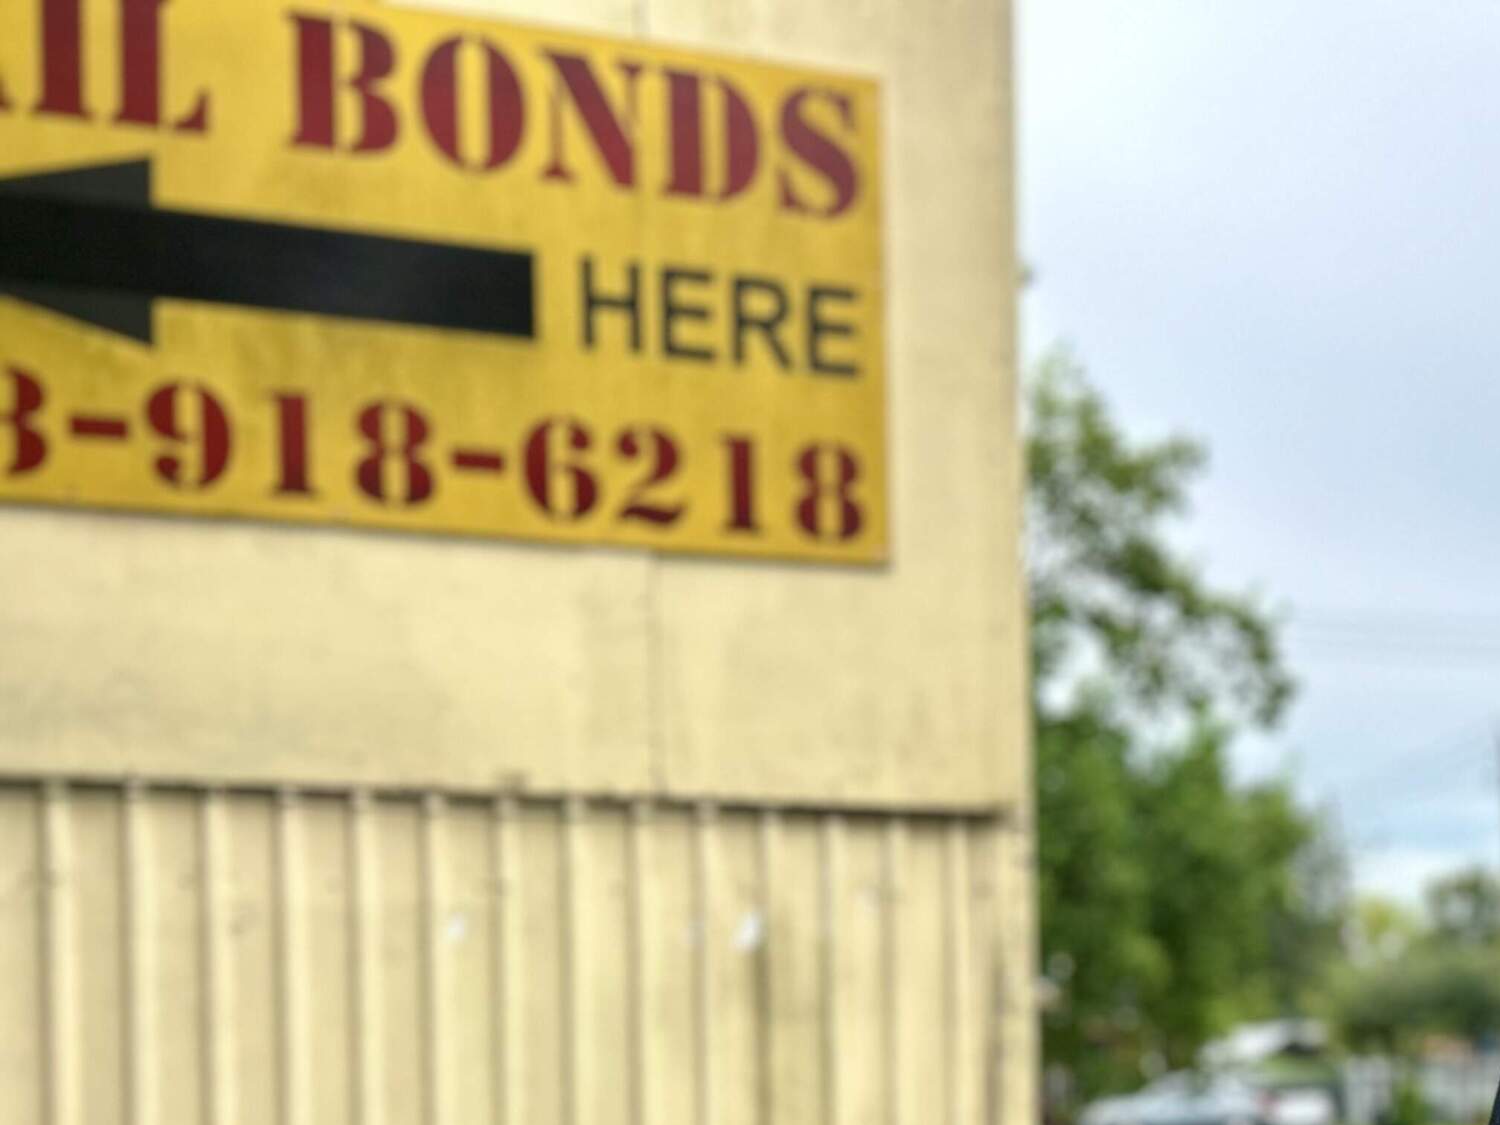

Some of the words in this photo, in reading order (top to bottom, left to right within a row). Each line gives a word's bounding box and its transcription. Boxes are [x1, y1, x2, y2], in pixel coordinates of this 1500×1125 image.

[0, 0, 210, 135] IL
[287, 8, 862, 219] BONDS
[580, 255, 863, 378] HERE
